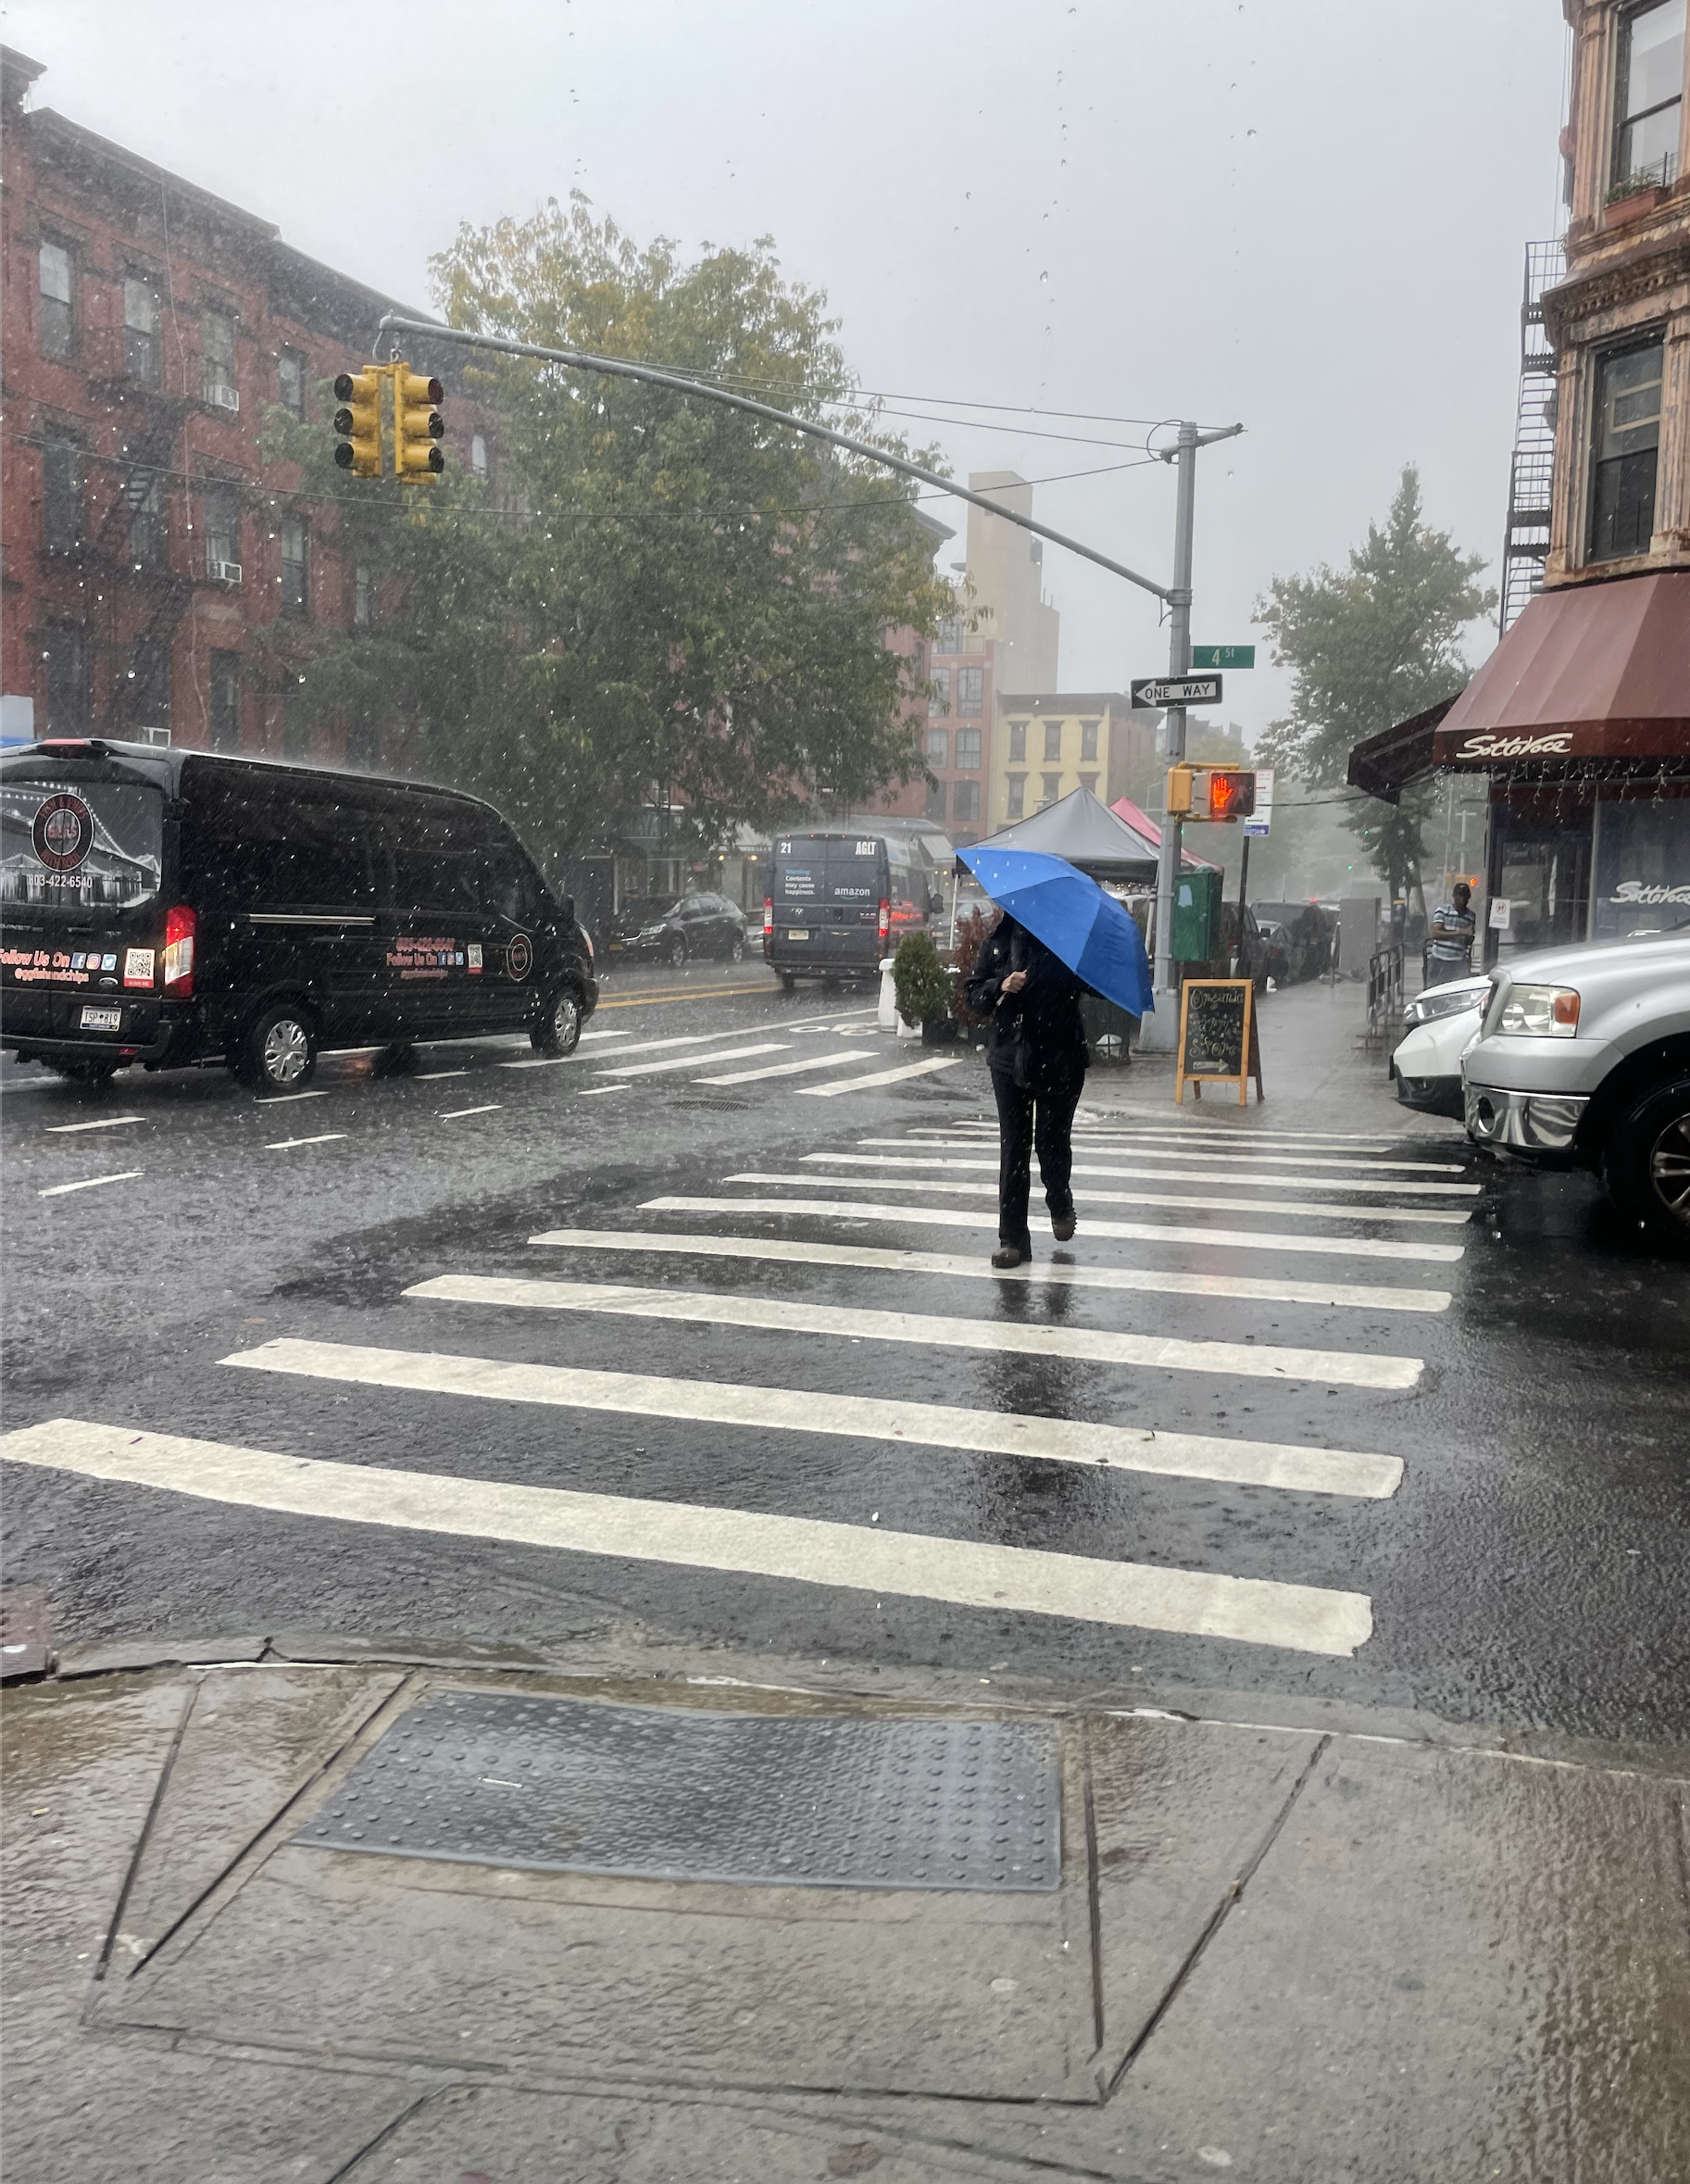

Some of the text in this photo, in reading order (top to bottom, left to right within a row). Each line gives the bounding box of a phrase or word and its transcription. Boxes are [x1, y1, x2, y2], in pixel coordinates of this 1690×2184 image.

[1211, 646, 1234, 666] 4 St
[1145, 684, 1210, 699] ONE WAY
[781, 842, 792, 854] 21
[855, 841, 877, 856] AGLT
[834, 887, 870, 897] amazon
[33, 950, 51, 967] Us
[52, 951, 71, 968] On
[386, 952, 438, 966] Follow Us On
[84, 1011, 119, 1024] TSP 819
